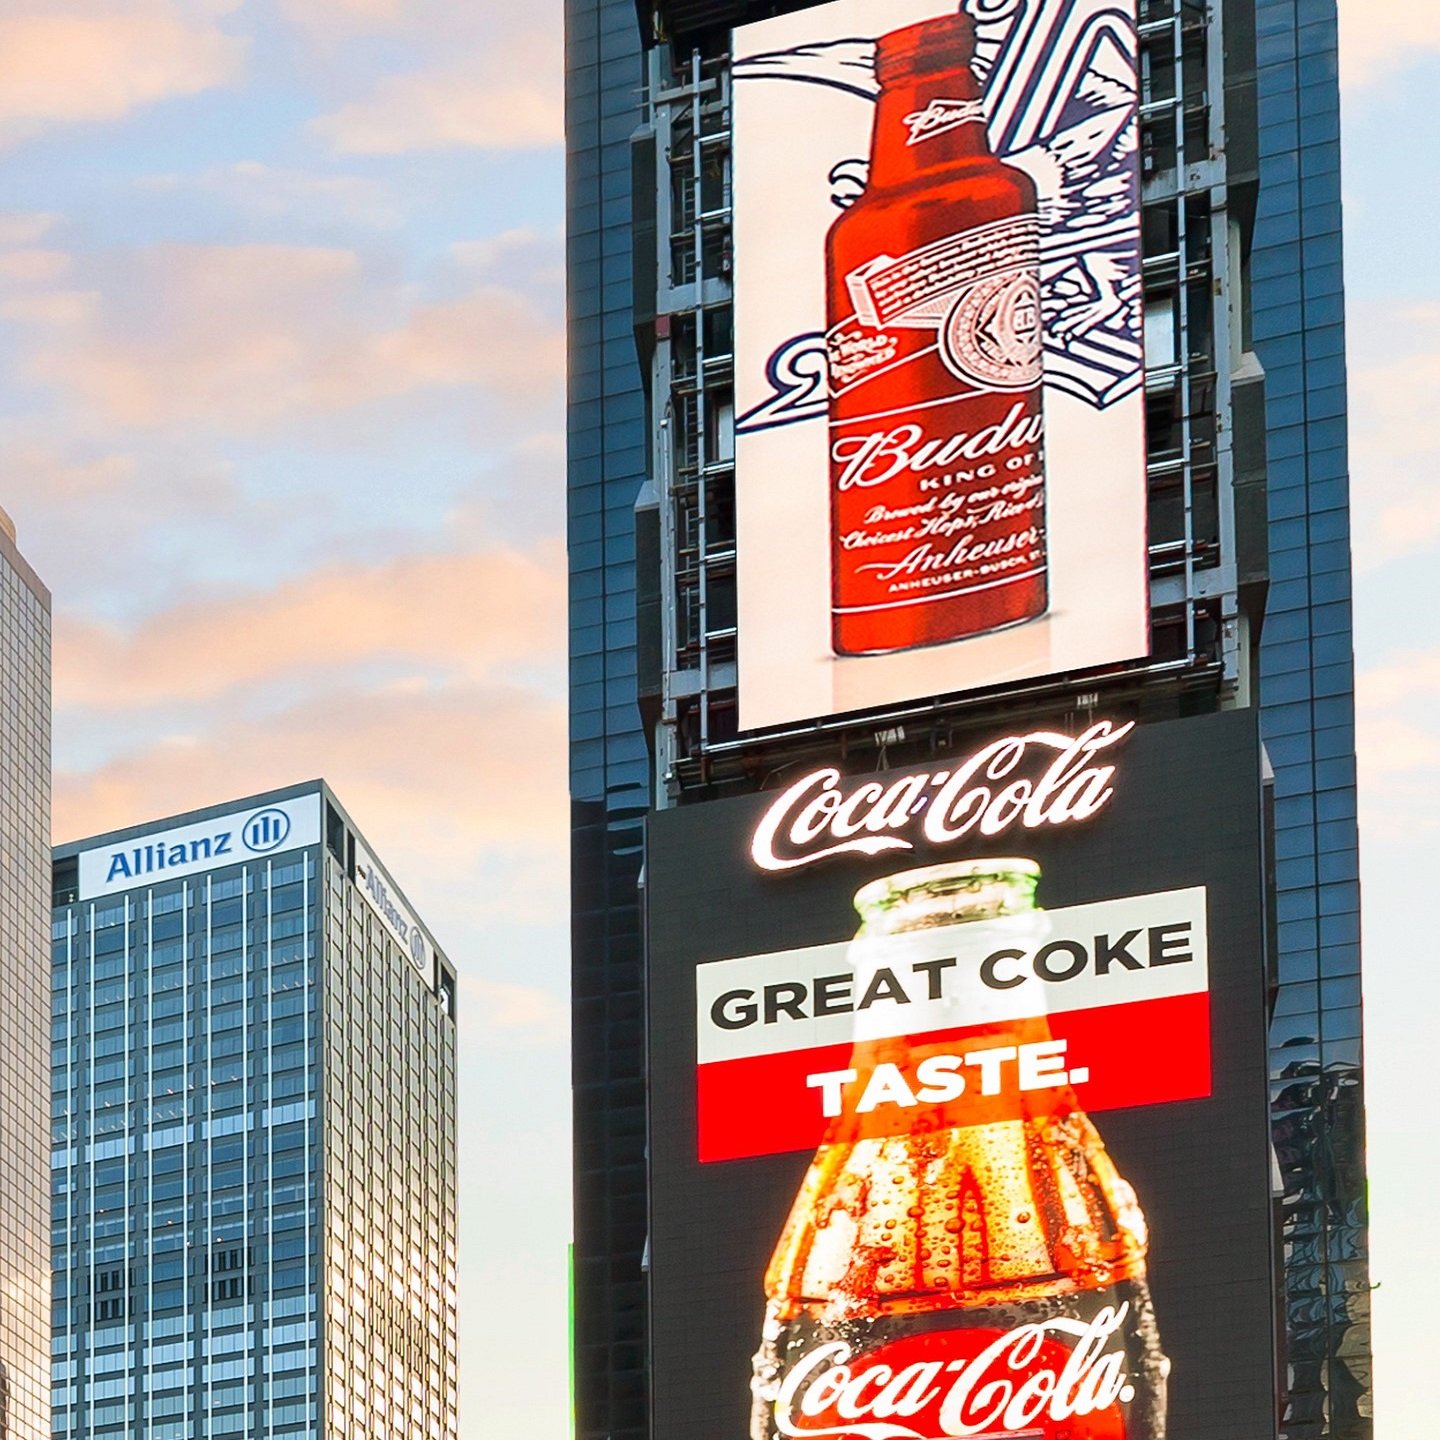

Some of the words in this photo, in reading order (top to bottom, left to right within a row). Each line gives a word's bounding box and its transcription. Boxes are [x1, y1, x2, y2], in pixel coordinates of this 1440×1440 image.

[864, 497, 938, 524] Brewed
[938, 492, 966, 514] by
[920, 463, 997, 491] KING
[839, 526, 915, 550] Choicest
[751, 719, 1135, 871] Coca-Cola
[105, 830, 232, 883] Allianz
[366, 865, 408, 945] Allianz
[710, 961, 946, 1031] GREAT
[980, 921, 1193, 989] COKE
[806, 1039, 1089, 1117] TASTE.
